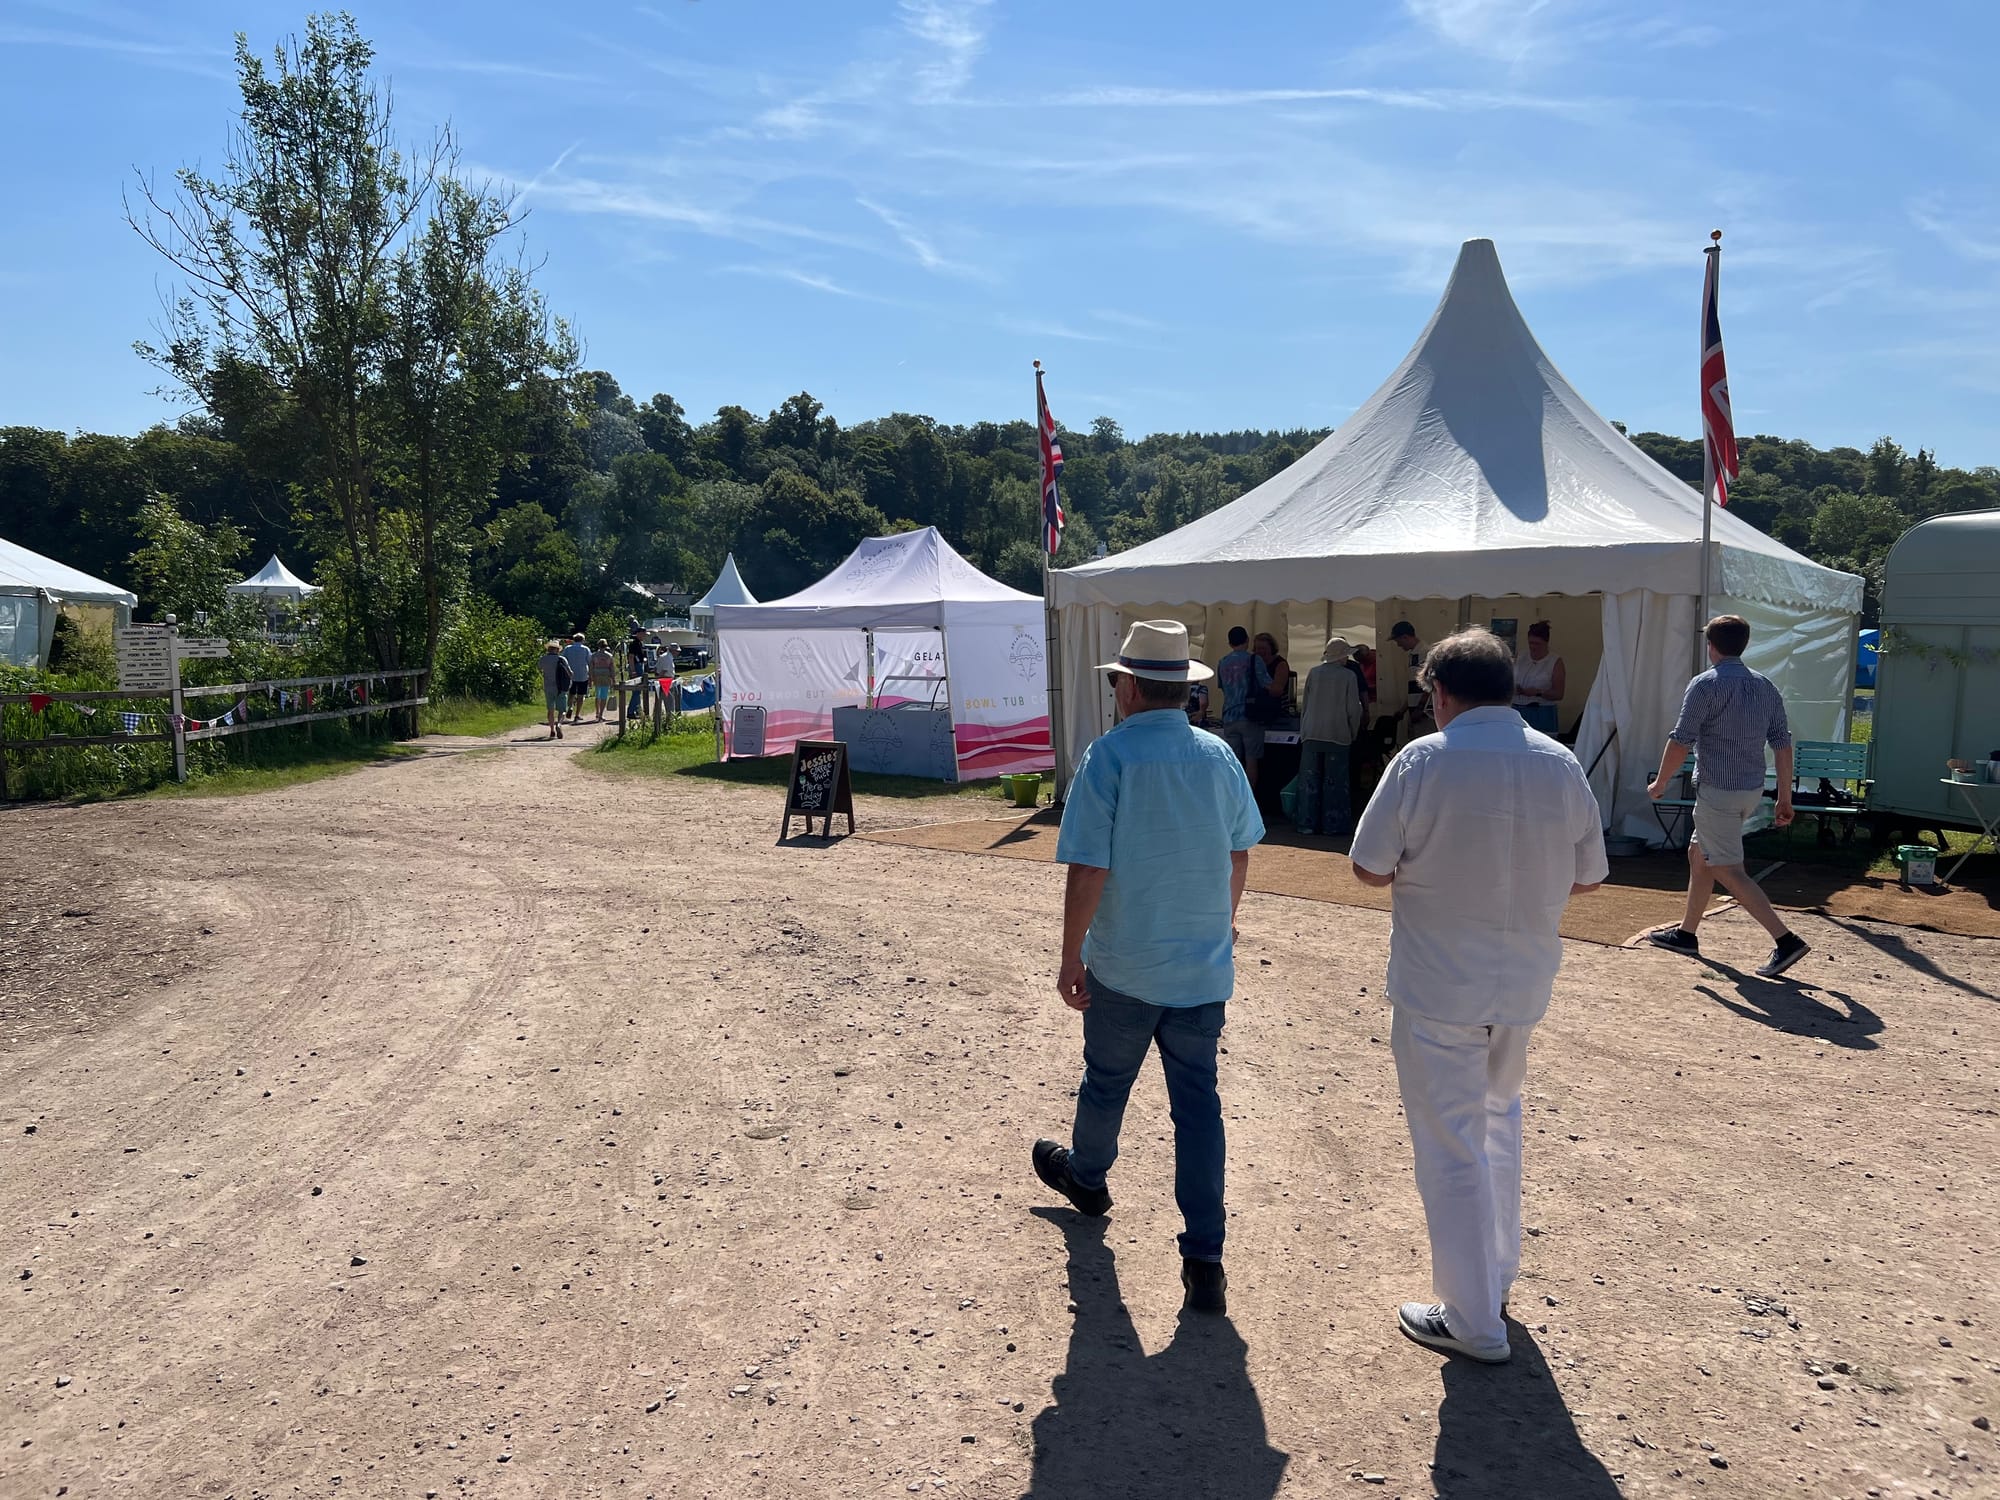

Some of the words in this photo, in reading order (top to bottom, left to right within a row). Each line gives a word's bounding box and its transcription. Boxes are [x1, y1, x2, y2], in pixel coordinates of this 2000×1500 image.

[914, 651, 945, 662] GELA
[965, 697, 997, 710] BOWL
[1003, 696, 1025, 707] TUB
[800, 751, 838, 772] Jessie's
[801, 781, 824, 793] Here
[798, 792, 822, 803] Today
